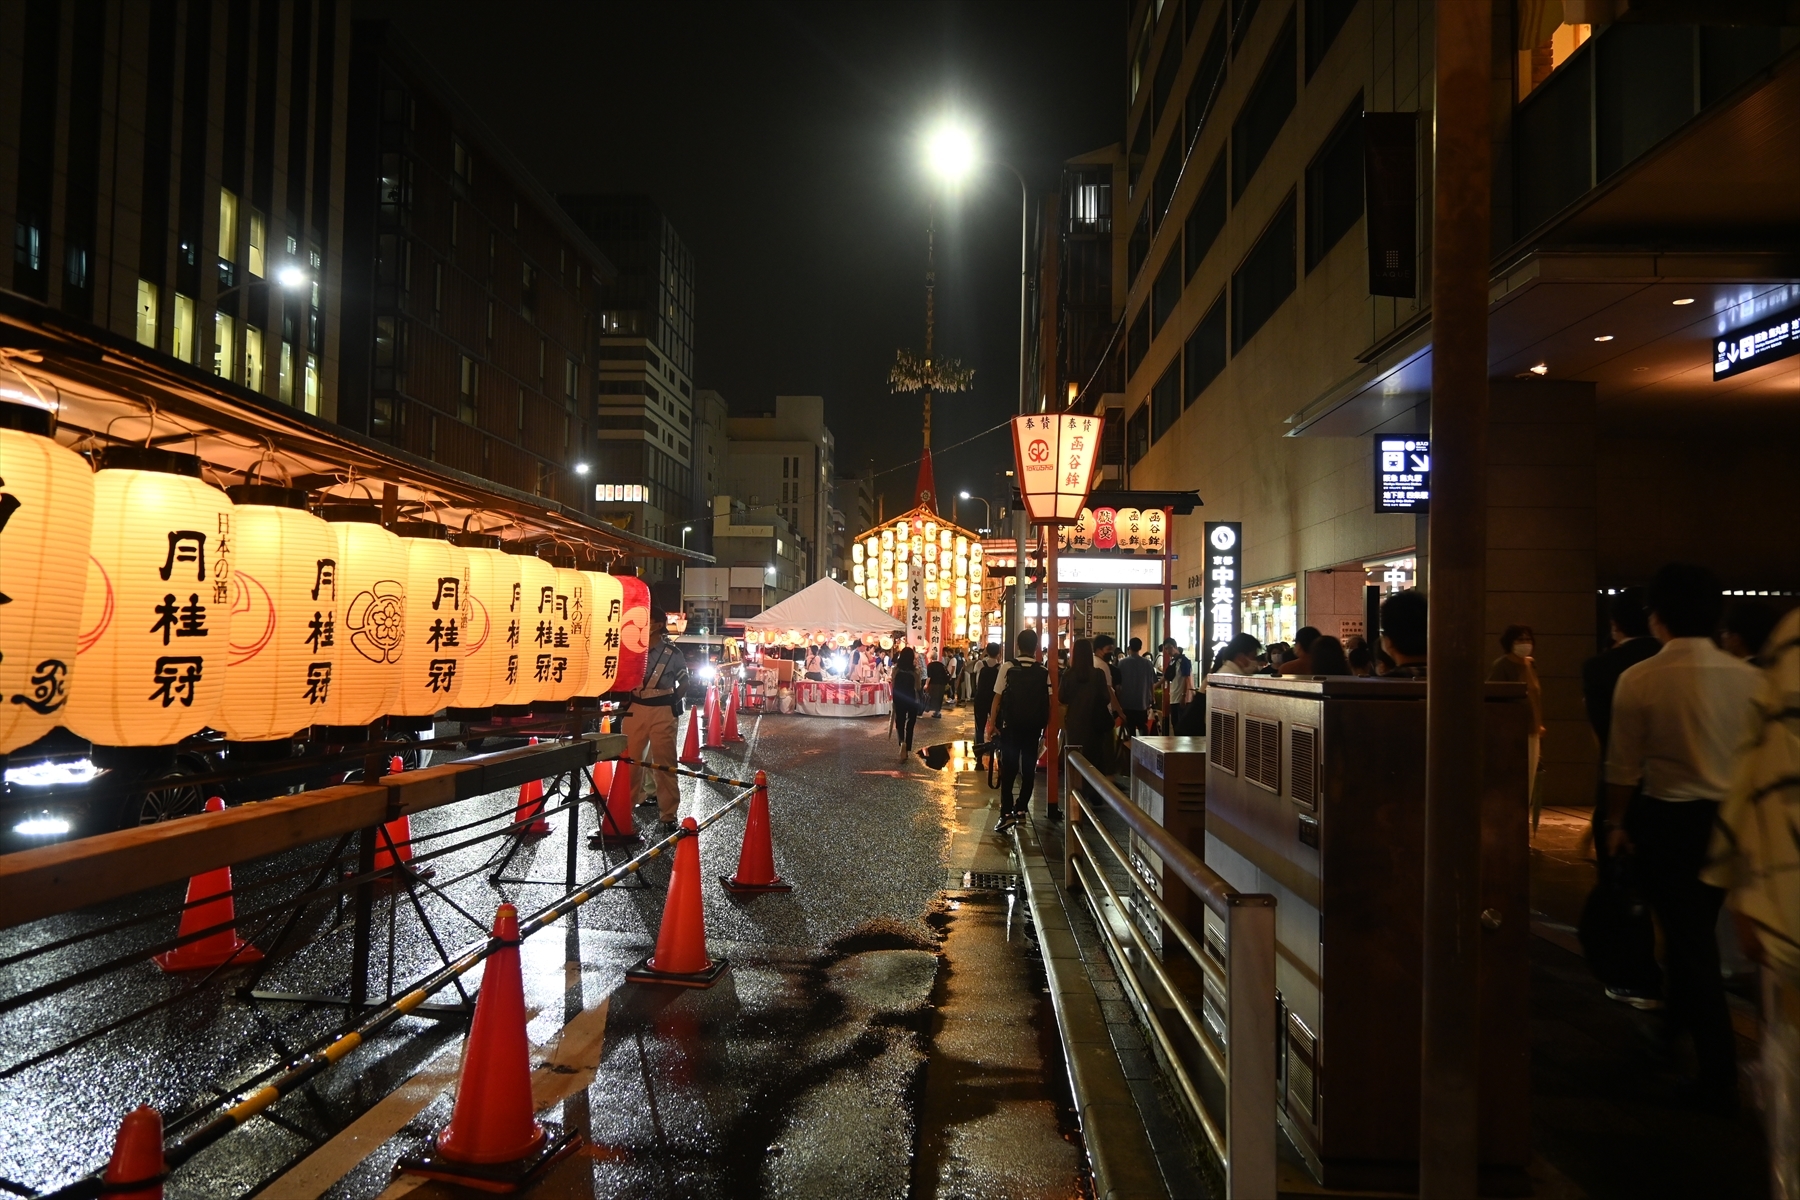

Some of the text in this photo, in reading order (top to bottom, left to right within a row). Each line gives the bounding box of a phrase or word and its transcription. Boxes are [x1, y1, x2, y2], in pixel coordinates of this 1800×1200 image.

[1065, 435, 1084, 488] 函谷鉾
[213, 513, 231, 604] 日本の酒
[1128, 511, 1140, 545] 函谷鉾
[1148, 512, 1162, 546] 函谷鉾
[571, 587, 583, 634] 日本の酒
[1384, 569, 1405, 592] 中
[149, 530, 209, 708] 月桂冠
[301, 559, 336, 704] 月桂冠
[425, 577, 460, 693] 月桂冠
[602, 599, 621, 680] 月桂冠
